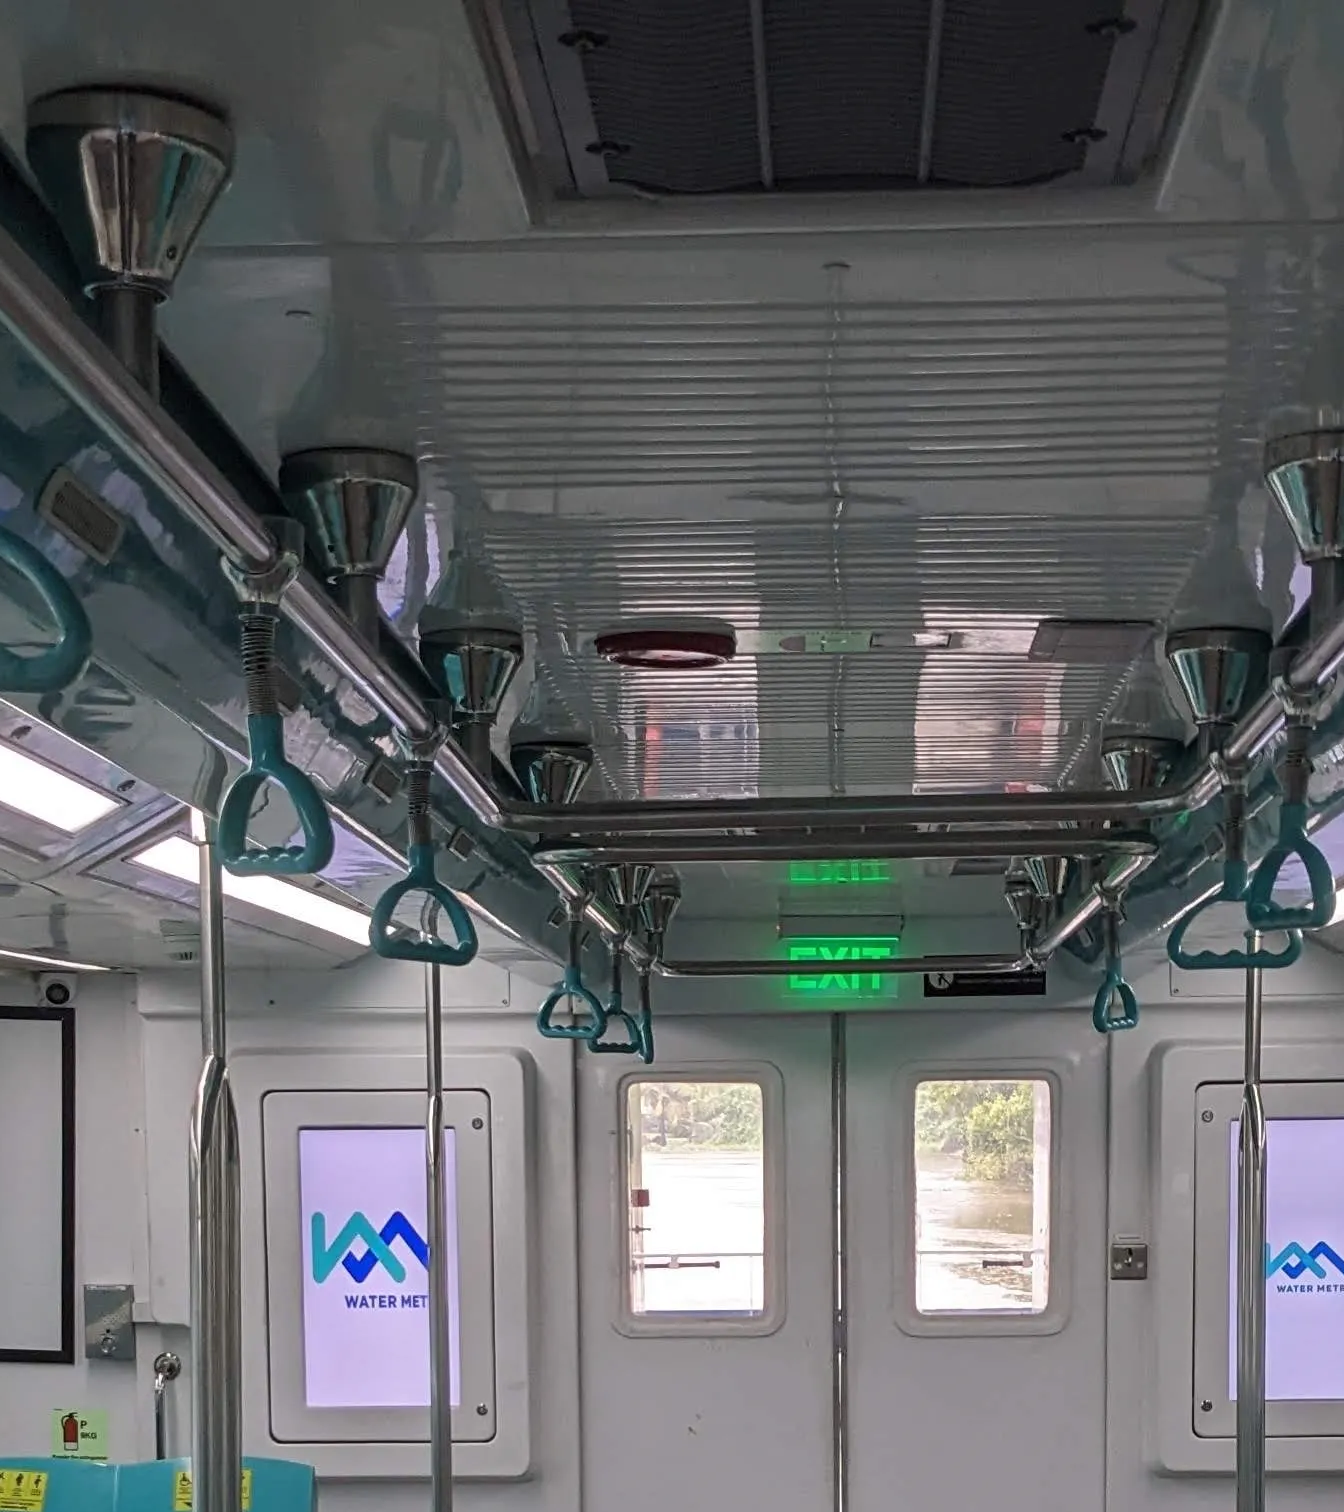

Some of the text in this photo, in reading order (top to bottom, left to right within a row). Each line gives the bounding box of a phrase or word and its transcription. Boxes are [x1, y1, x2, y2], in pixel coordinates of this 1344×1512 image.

[790, 947, 891, 989] EXIT
[1276, 1284, 1313, 1293] WATER
[344, 1294, 428, 1309] WATER MET
